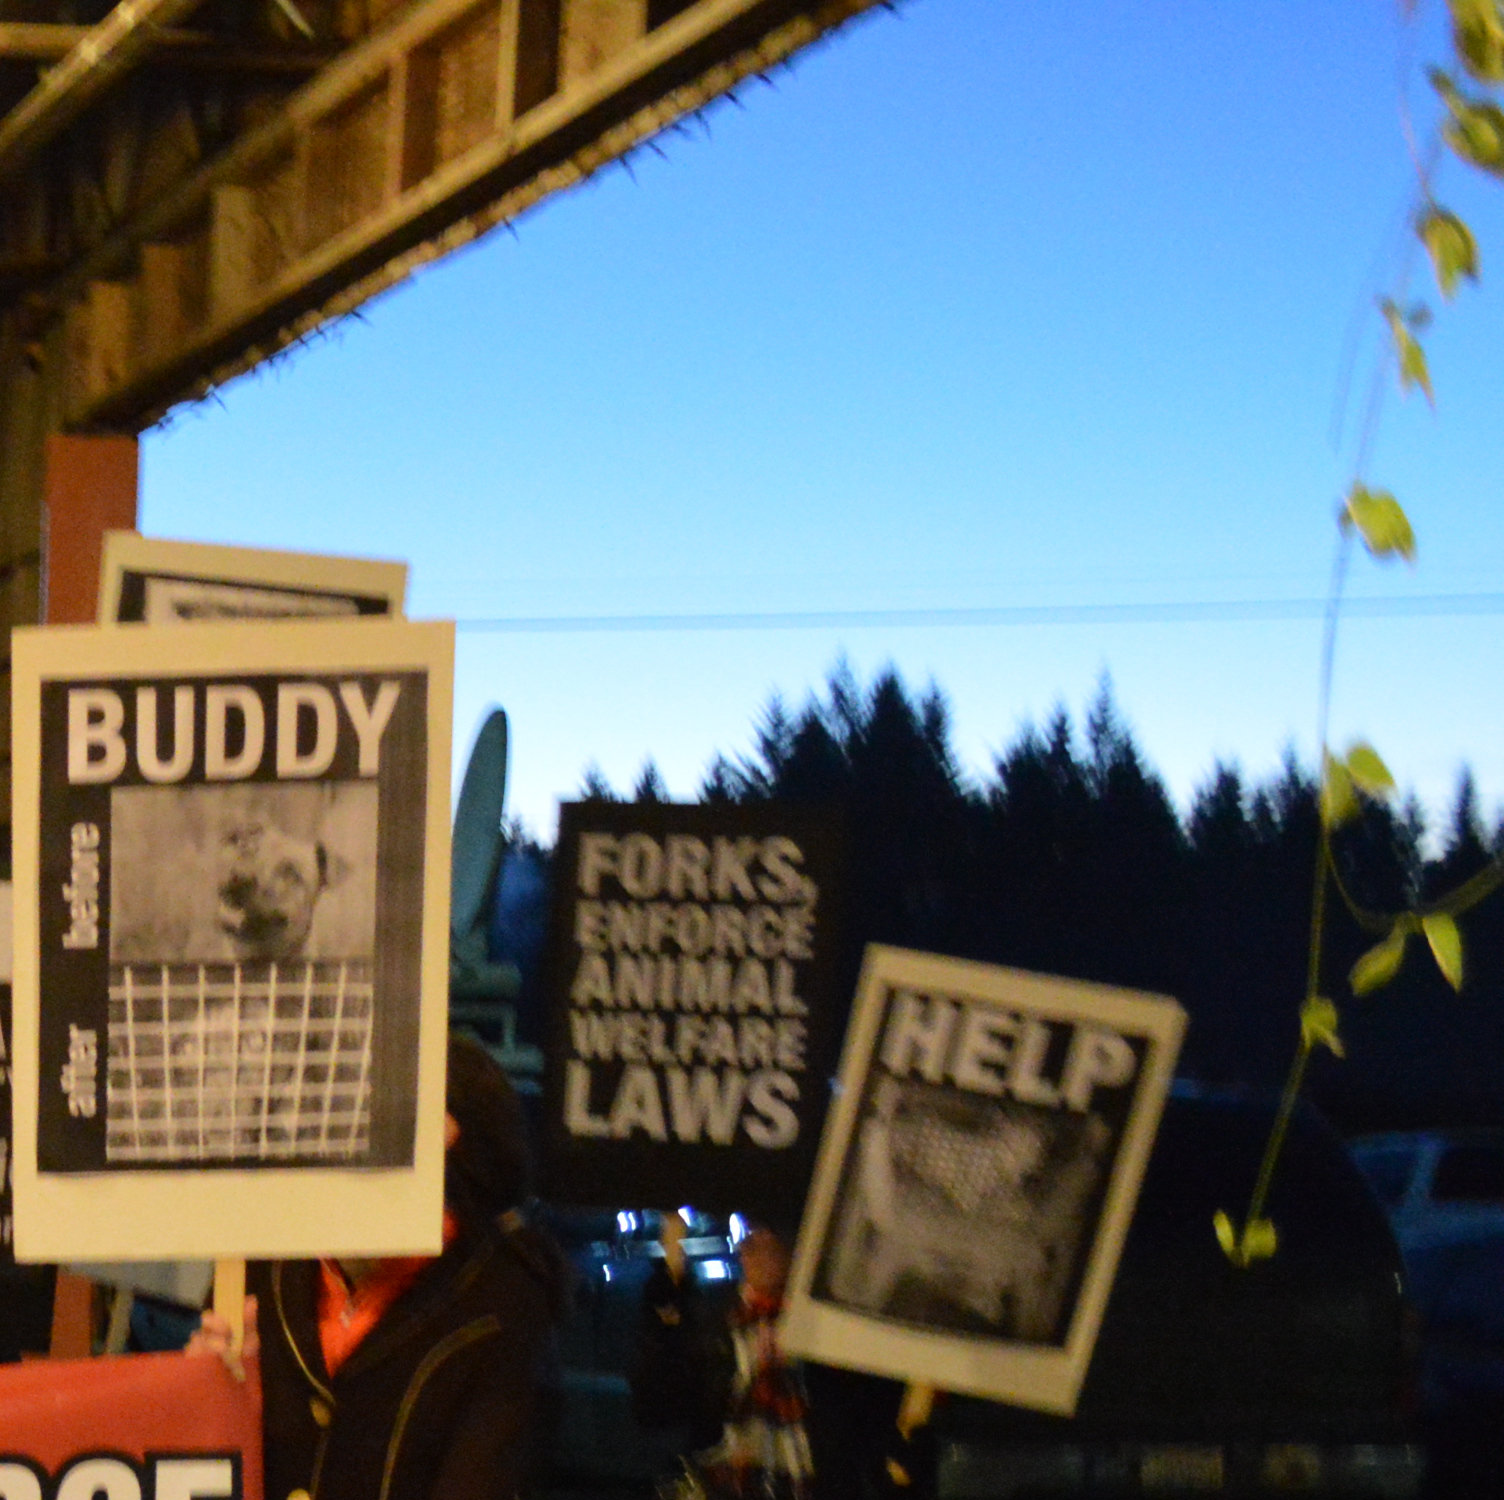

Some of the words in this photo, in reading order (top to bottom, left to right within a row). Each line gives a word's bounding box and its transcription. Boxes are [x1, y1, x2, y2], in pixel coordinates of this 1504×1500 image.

[68, 681, 400, 786] BUDDY
[63, 821, 99, 949] before
[575, 899, 814, 960] ENFORCE
[570, 950, 808, 1015] ANIMAL
[61, 1023, 97, 1118] after
[570, 1009, 808, 1071] WELFARE
[881, 994, 1136, 1112] HELP
[564, 1058, 800, 1149] LAWS
